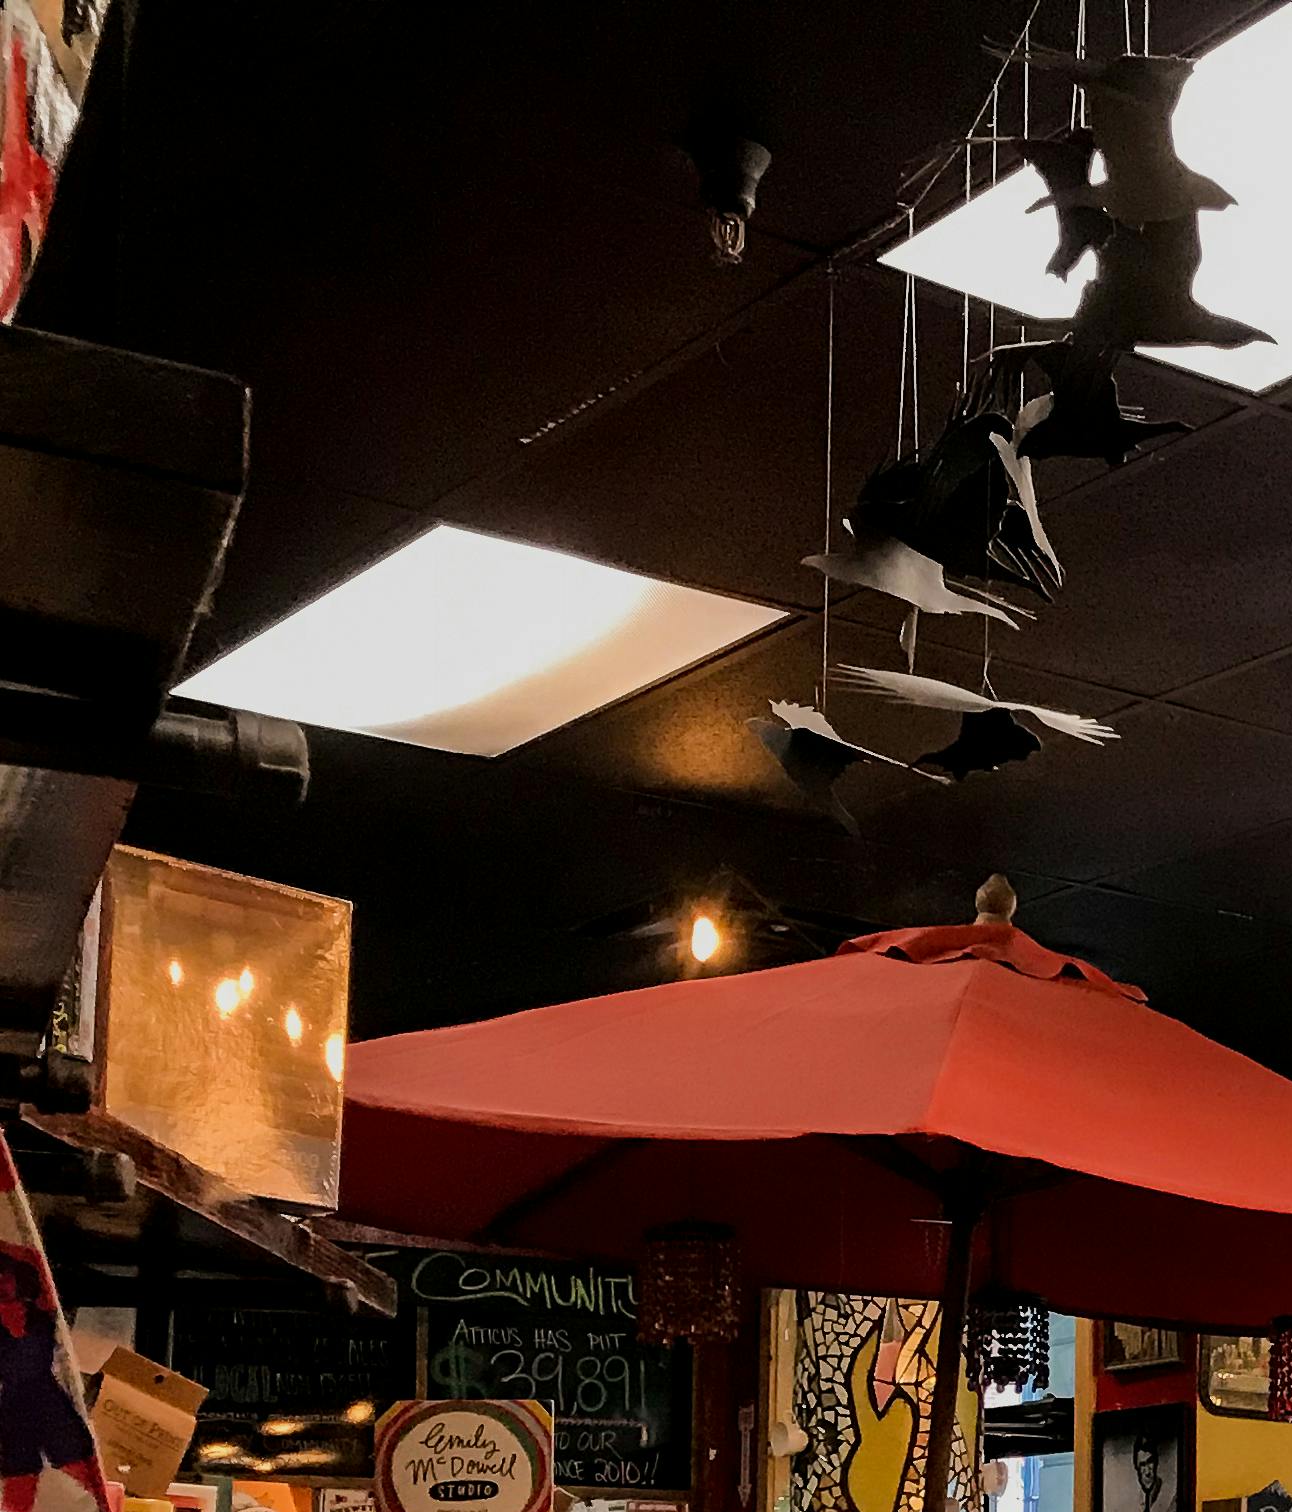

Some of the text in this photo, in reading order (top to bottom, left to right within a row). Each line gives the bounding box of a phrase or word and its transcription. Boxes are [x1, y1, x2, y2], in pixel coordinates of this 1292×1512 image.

[452, 1319, 522, 1348] ATTICUS
[534, 1329, 572, 1351] HAS
[419, 1422, 500, 1459] Emily
[553, 1459, 585, 1481] INCE
[437, 1484, 494, 1499] STUDIO
